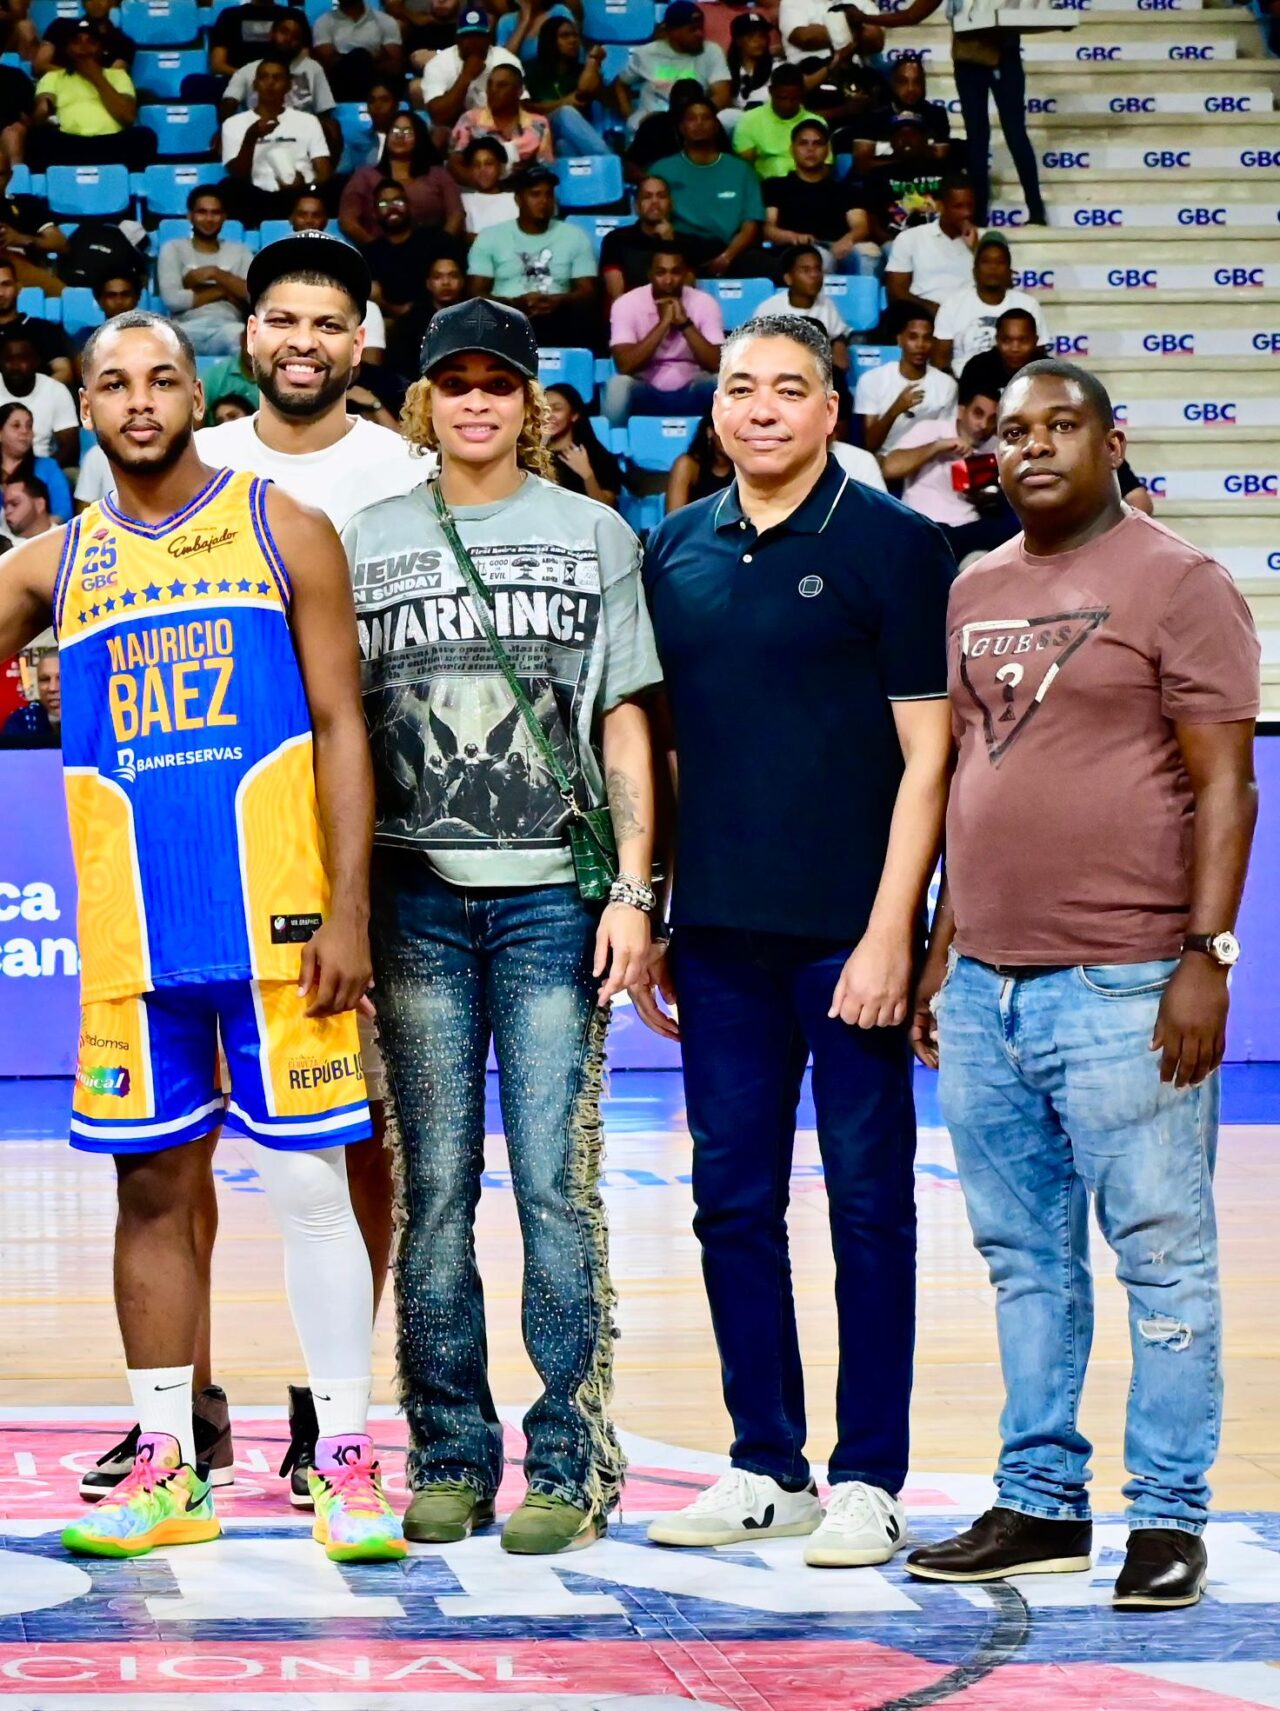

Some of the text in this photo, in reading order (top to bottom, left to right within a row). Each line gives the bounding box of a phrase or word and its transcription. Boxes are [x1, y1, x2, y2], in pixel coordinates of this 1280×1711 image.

[1076, 46, 1122, 61] GBC
[1169, 46, 1214, 61] GBC
[1023, 98, 1056, 113] BC
[1109, 98, 1155, 113] GBC
[1204, 97, 1250, 112] GBC
[1042, 152, 1090, 168] GBC
[1143, 151, 1191, 167] GBC
[986, 208, 1226, 227] BC GBC GBC
[1108, 269, 1157, 288] GBC
[1214, 268, 1264, 287] GBC
[1143, 334, 1194, 355] GBC
[1252, 333, 1280, 354] GB
[1183, 403, 1236, 424] GBC
[1224, 475, 1277, 496] GBC
[167, 528, 239, 558] Embajador
[82, 537, 117, 574] 25
[489, 559, 509, 567] GOOD
[81, 571, 118, 592] GBC
[489, 572, 506, 580] EVIL
[372, 575, 440, 601] SUNDAY
[358, 591, 587, 661] WARNING!
[106, 618, 233, 672] MAURICIO
[971, 626, 1072, 658] GUESS
[136, 747, 243, 772] BANRESERVAS
